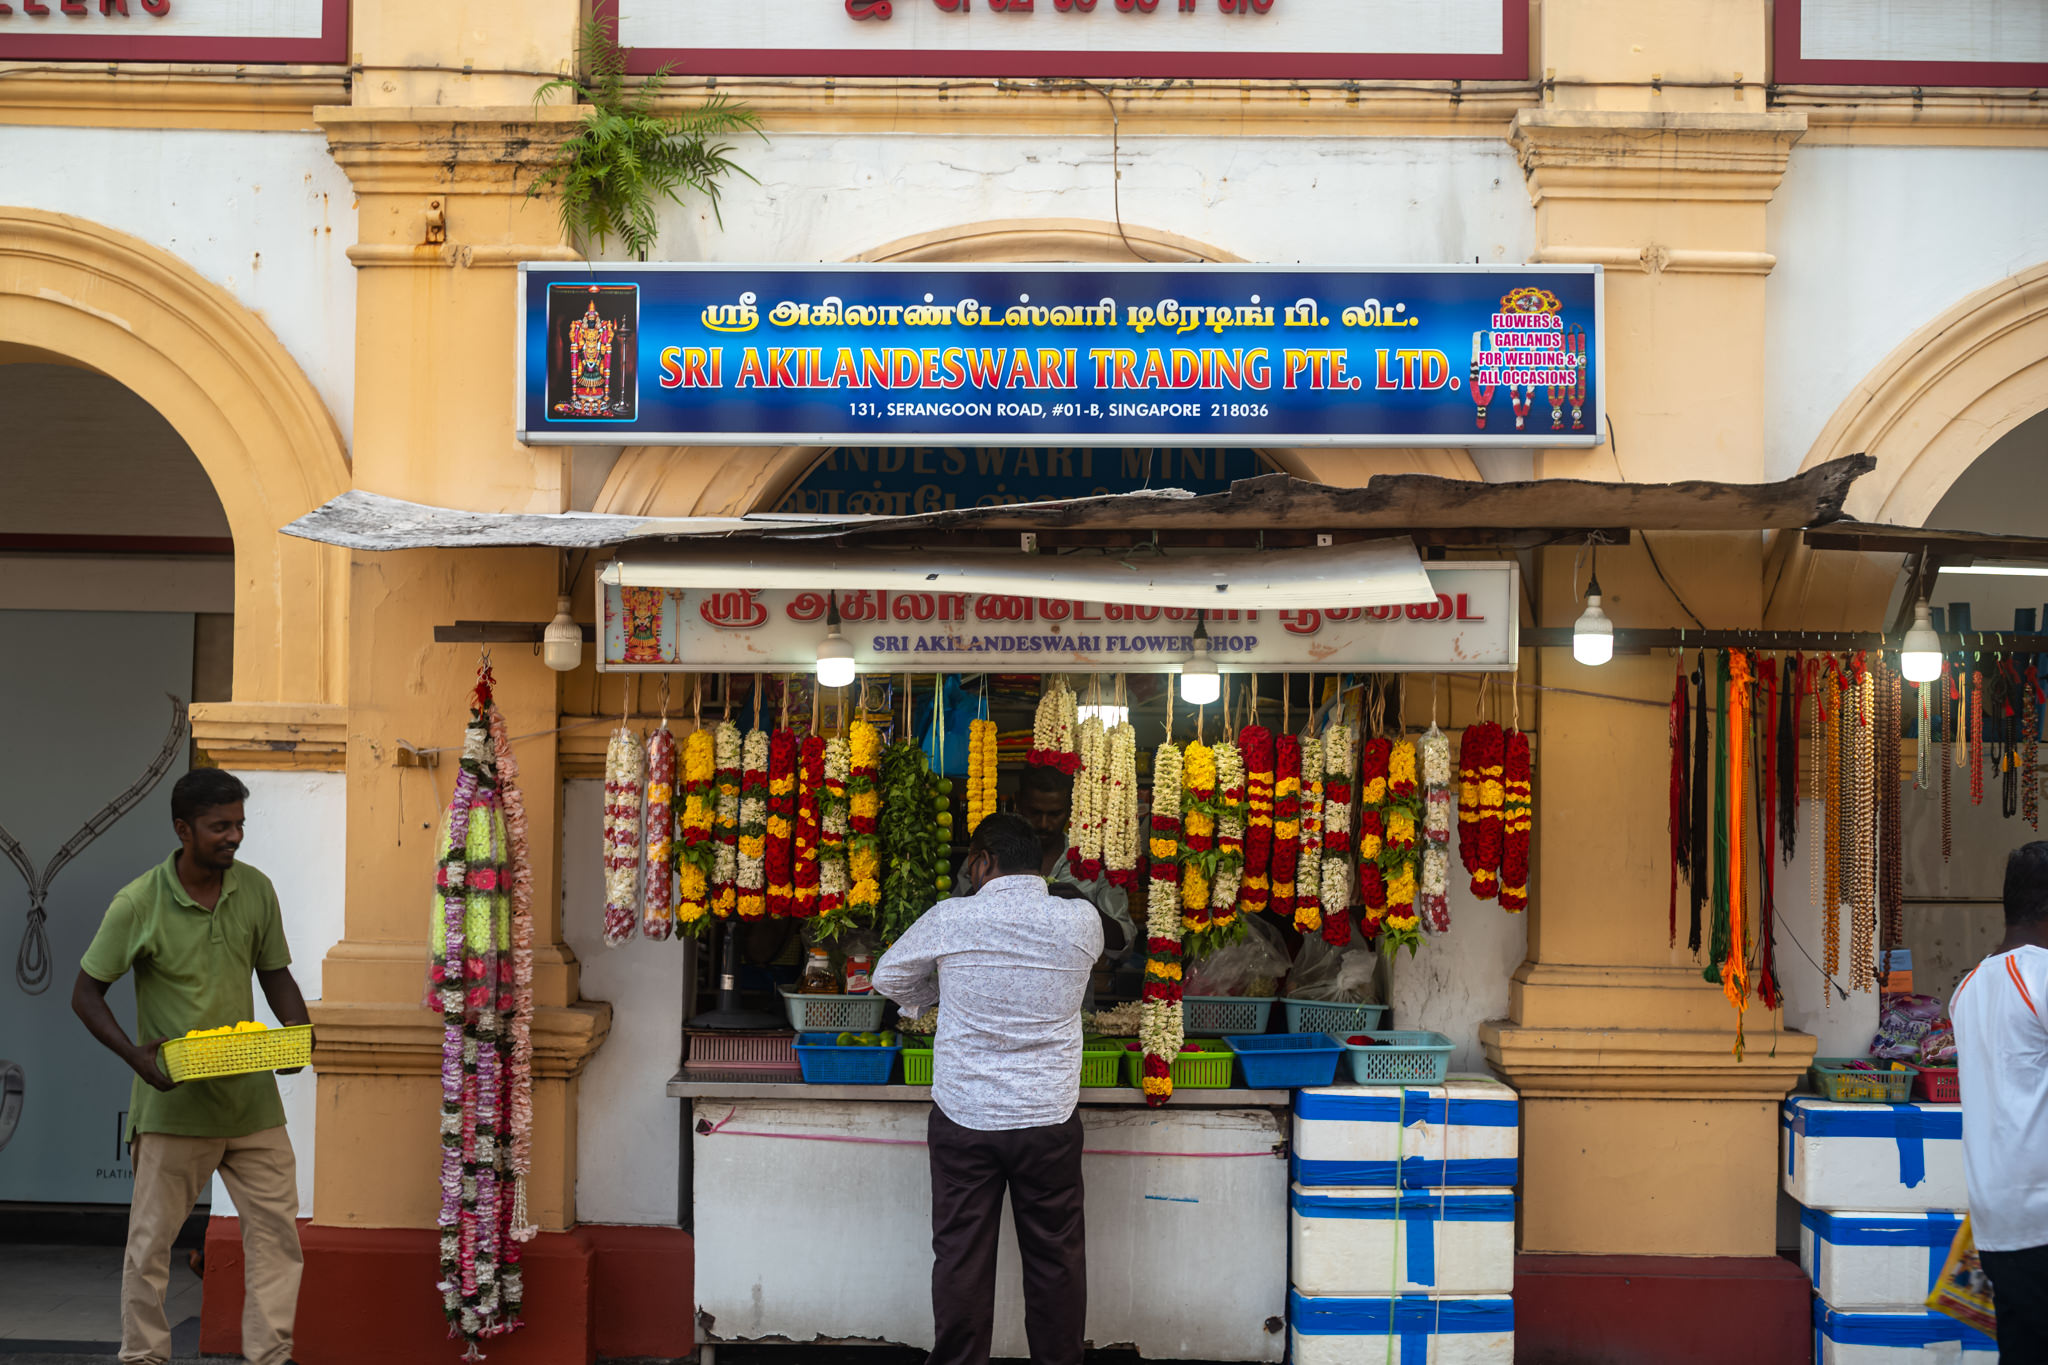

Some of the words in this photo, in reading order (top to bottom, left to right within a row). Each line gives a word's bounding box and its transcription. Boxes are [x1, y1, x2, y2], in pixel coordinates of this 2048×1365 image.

[1126, 294, 1275, 335] டிரேடிங்
[1284, 298, 1330, 327] பி.
[1341, 298, 1419, 327] லிட்.
[1492, 314, 1550, 328] FLOWERS
[1552, 316, 1562, 328] &
[1494, 333, 1560, 347] GARLANDS
[1479, 352, 1502, 366] FOR
[1505, 352, 1564, 366] WEDDING
[1567, 354, 1577, 366] &
[659, 347, 723, 388] SRI
[735, 347, 1078, 389] AKILANDESWARI
[1088, 347, 1271, 390] TRADING
[1283, 348, 1362, 390] PTE.
[1375, 348, 1460, 390] LTD.
[1480, 371, 1500, 385] ALL
[1502, 371, 1576, 385] OCCASIONS
[850, 403, 883, 418] 131,
[887, 403, 991, 417] SERANGOON
[997, 403, 1047, 418] ROAD,
[1052, 403, 1104, 419] #01-B,
[1109, 403, 1200, 417] SINGAPORE
[1211, 403, 1269, 417] 218036
[873, 635, 909, 651] SRI
[915, 635, 1100, 651] AKILANDESWARI
[1106, 636, 1195, 651] FLOWER
